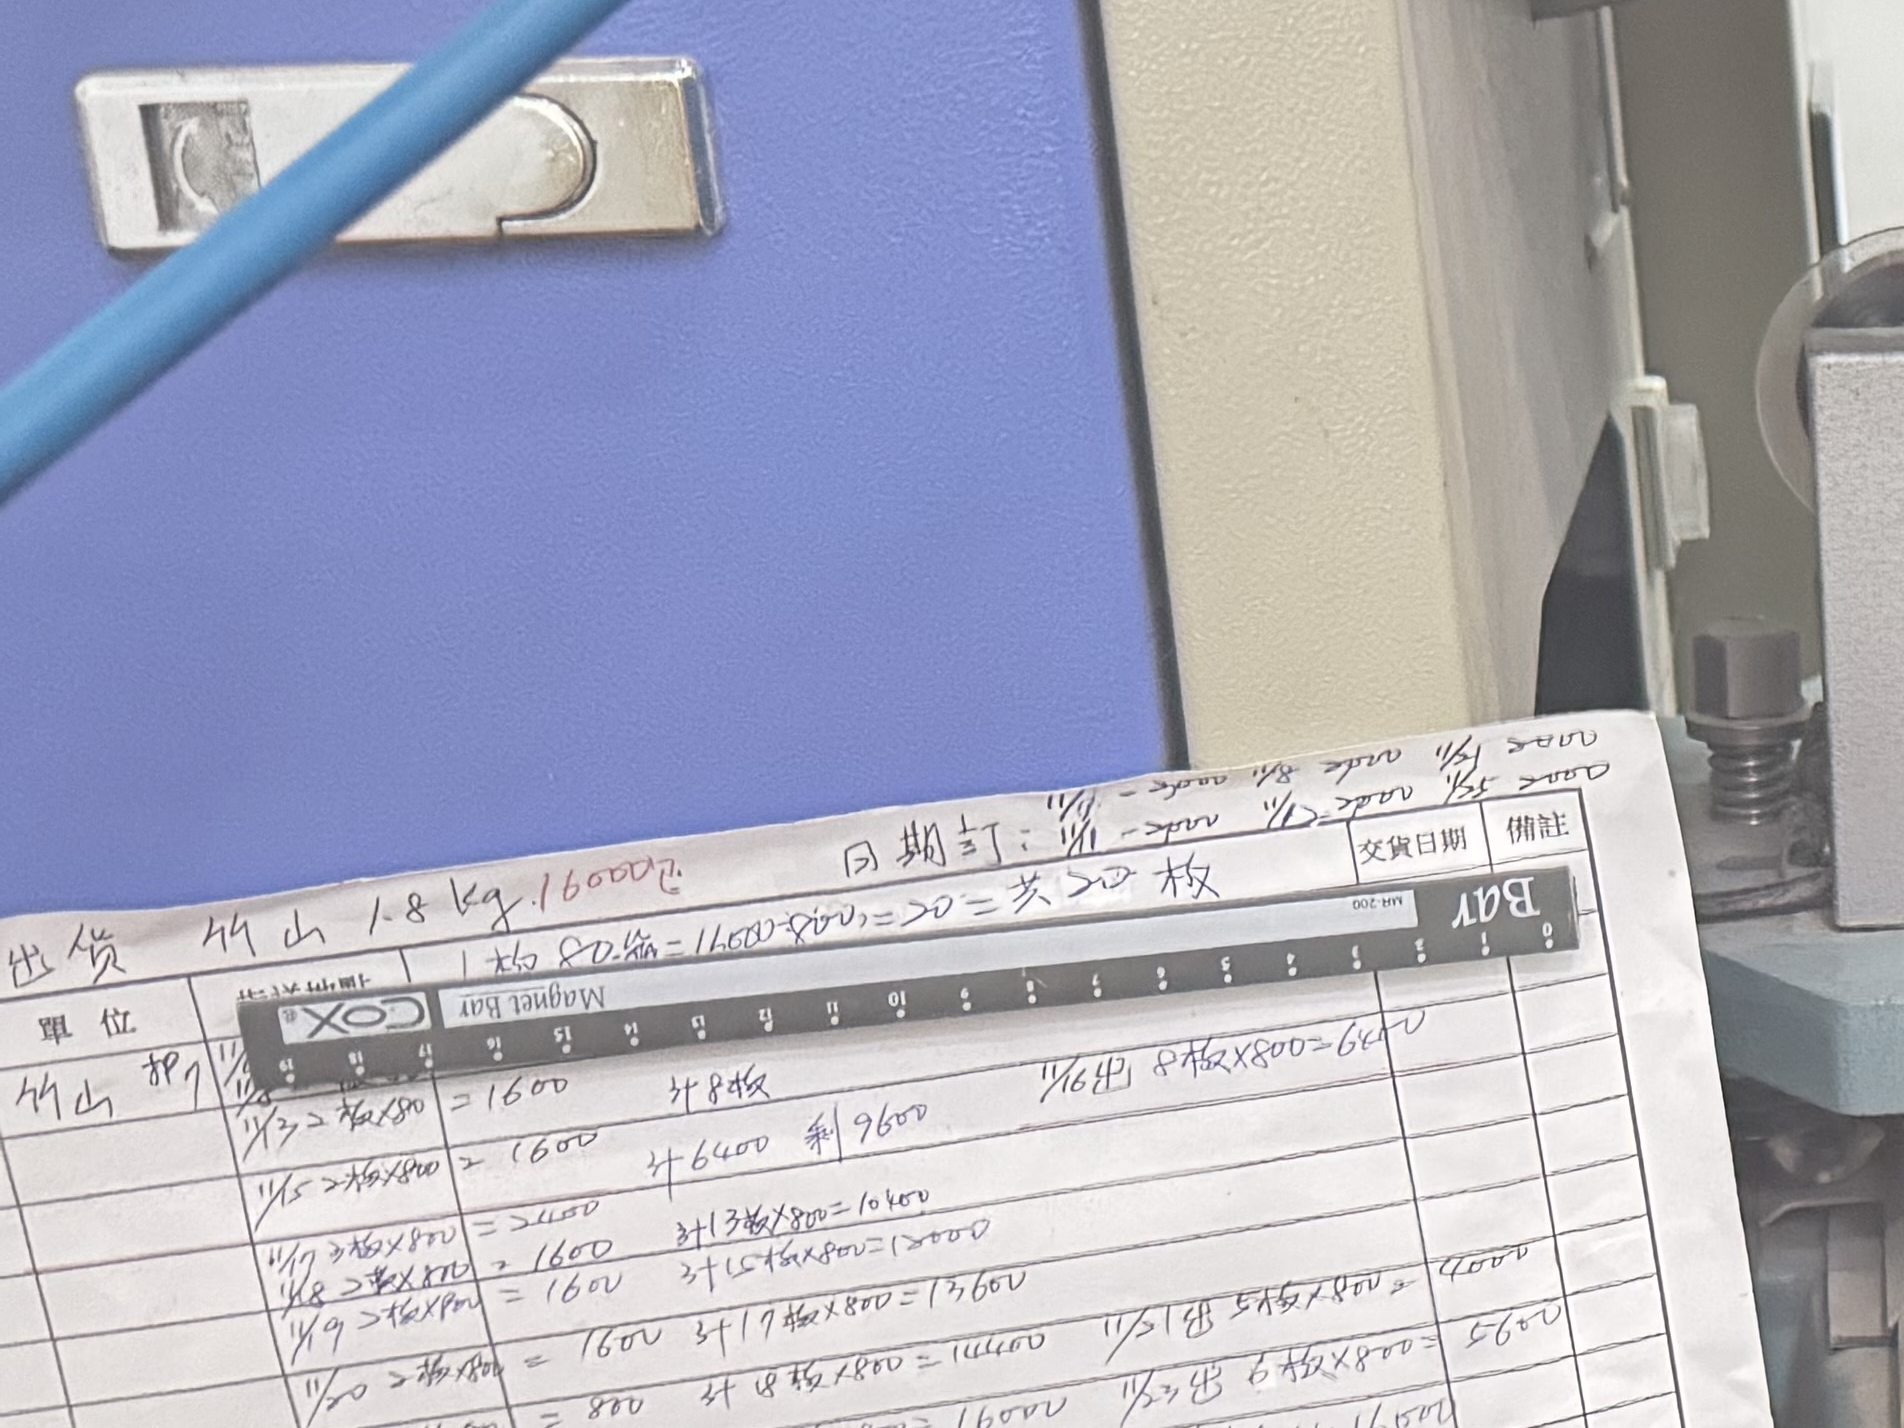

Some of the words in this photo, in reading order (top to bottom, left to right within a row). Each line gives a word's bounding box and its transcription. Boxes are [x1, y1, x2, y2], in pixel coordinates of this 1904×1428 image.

[1358, 825, 1468, 866] 交貨日期
[1506, 811, 1570, 846] 備註
[1450, 876, 1541, 930] Bar
[457, 991, 502, 1021] Bar
[506, 984, 606, 1016] Magnet
[38, 1007, 137, 1046] 單位
